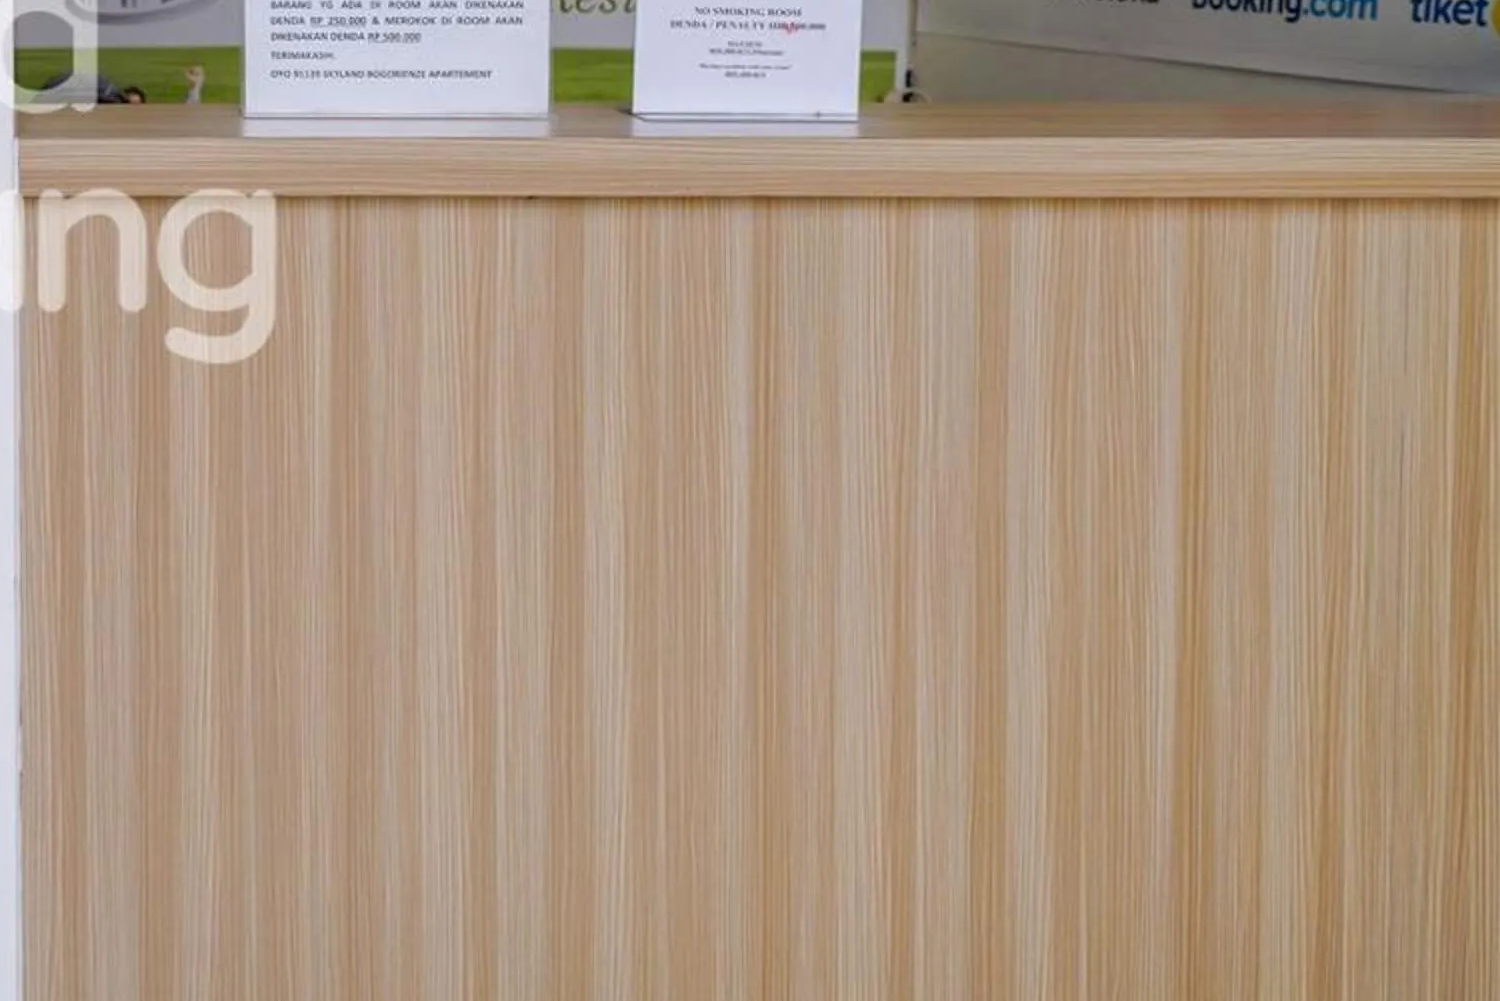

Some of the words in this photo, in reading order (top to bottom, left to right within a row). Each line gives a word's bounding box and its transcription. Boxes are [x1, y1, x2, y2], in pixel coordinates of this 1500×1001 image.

[270, 0, 312, 10] BARANG
[320, 0, 334, 10] YG
[341, 0, 363, 10] ADA
[370, 0, 381, 10] DI
[388, 0, 421, 10] ROOM
[428, 0, 457, 10] AKAN
[465, 0, 524, 10] DIKENAKAN
[270, 16, 305, 26] DENDA
[385, 16, 436, 26] MEROKOK
[441, 16, 452, 26] DI
[456, 16, 490, 26] ROOM
[495, 16, 523, 26] AKAN
[270, 32, 328, 42] DIKENAKAN
[330, 32, 365, 42] DENDA
[323, 70, 365, 80] SKYLAND
